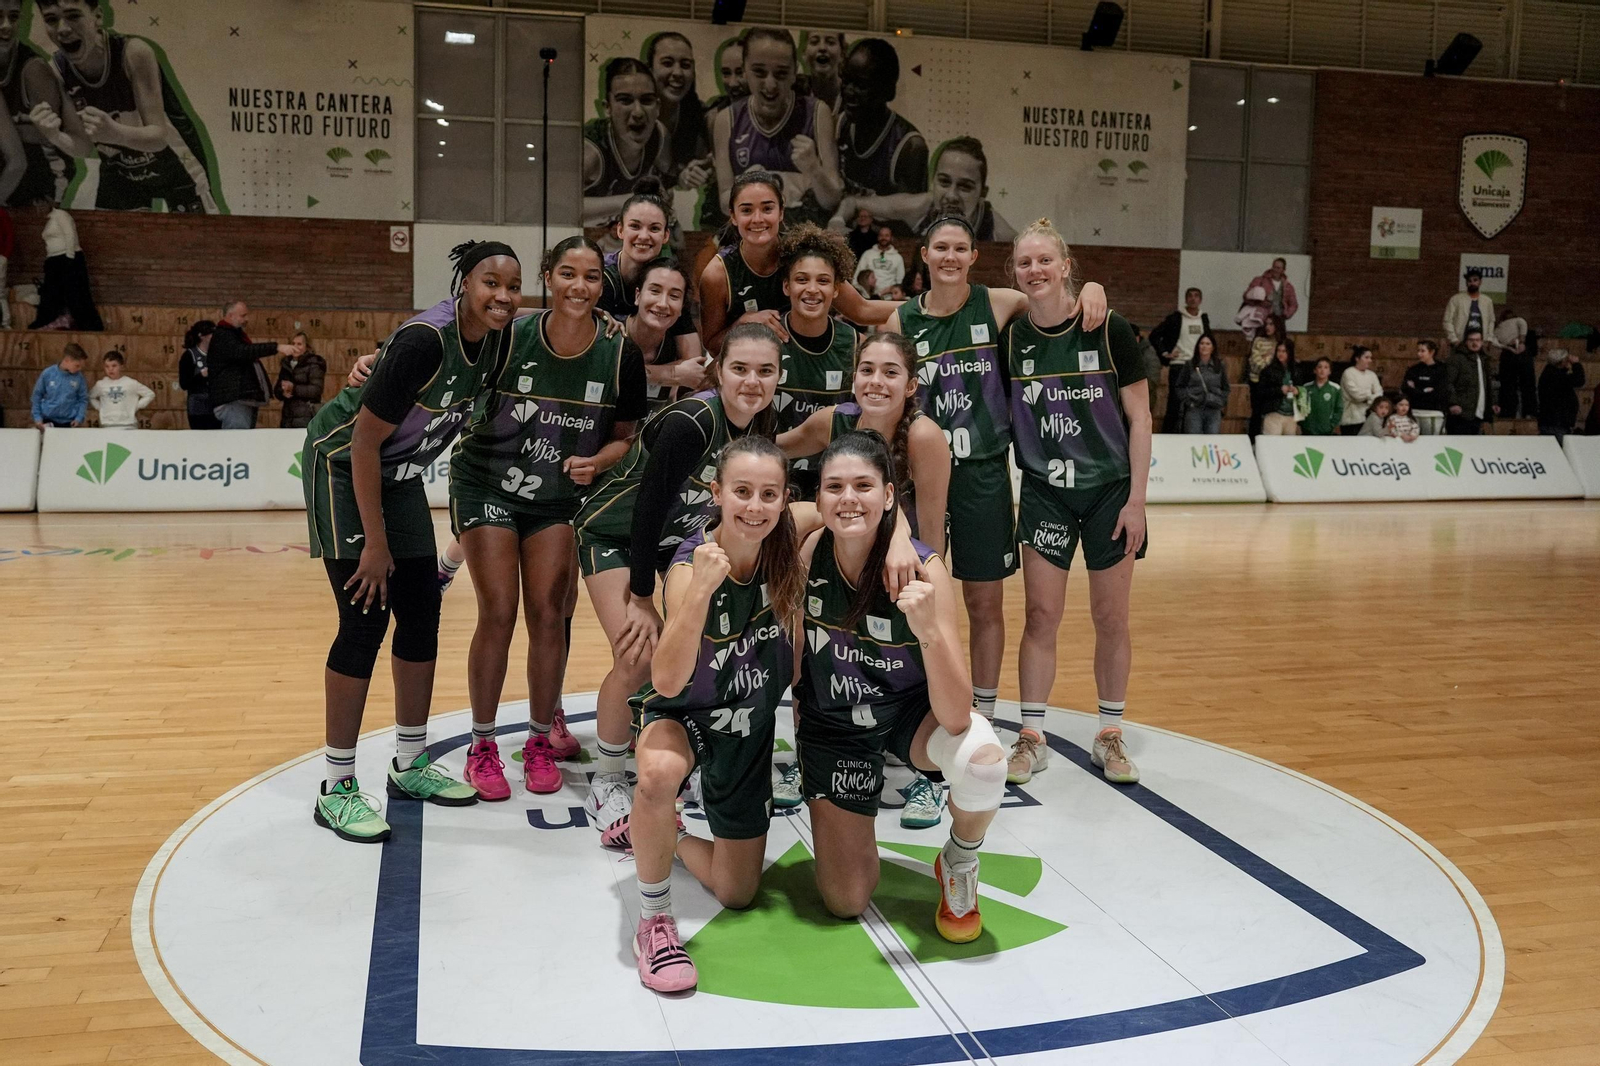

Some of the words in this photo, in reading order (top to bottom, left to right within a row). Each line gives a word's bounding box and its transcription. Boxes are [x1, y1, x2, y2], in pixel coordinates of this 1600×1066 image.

[229, 88, 307, 110] NUESTRA
[316, 92, 393, 115] CANTERA
[231, 111, 313, 136] NUESTRO
[322, 116, 390, 140] FUTURO
[1023, 106, 1085, 126] NUESTRA
[1091, 110, 1152, 130] CANTERA
[1024, 126, 1089, 148] NUESTRO
[1096, 130, 1150, 152] FUTURO
[1473, 184, 1511, 198] Unicaja
[177, 316, 188, 325] 15
[940, 358, 992, 376] Unicaja
[152, 380, 164, 390] 15
[1046, 384, 1104, 402] Unicaja
[936, 388, 972, 418] Mijas
[540, 410, 595, 432] Unicaja
[1040, 412, 1082, 443] Mijas
[521, 438, 562, 464] Mijas
[1191, 443, 1242, 474] Mijas
[138, 458, 250, 487] Unicaja
[1048, 458, 1075, 488] 21
[1332, 457, 1412, 480] Unicaja
[1471, 455, 1547, 477] Unicaja
[501, 466, 543, 500] 32
[734, 624, 780, 656] Unica
[834, 644, 904, 672] Unicaja
[830, 673, 884, 704] Mijas
[710, 706, 756, 738] 24
[836, 760, 872, 770] CLINICAS
